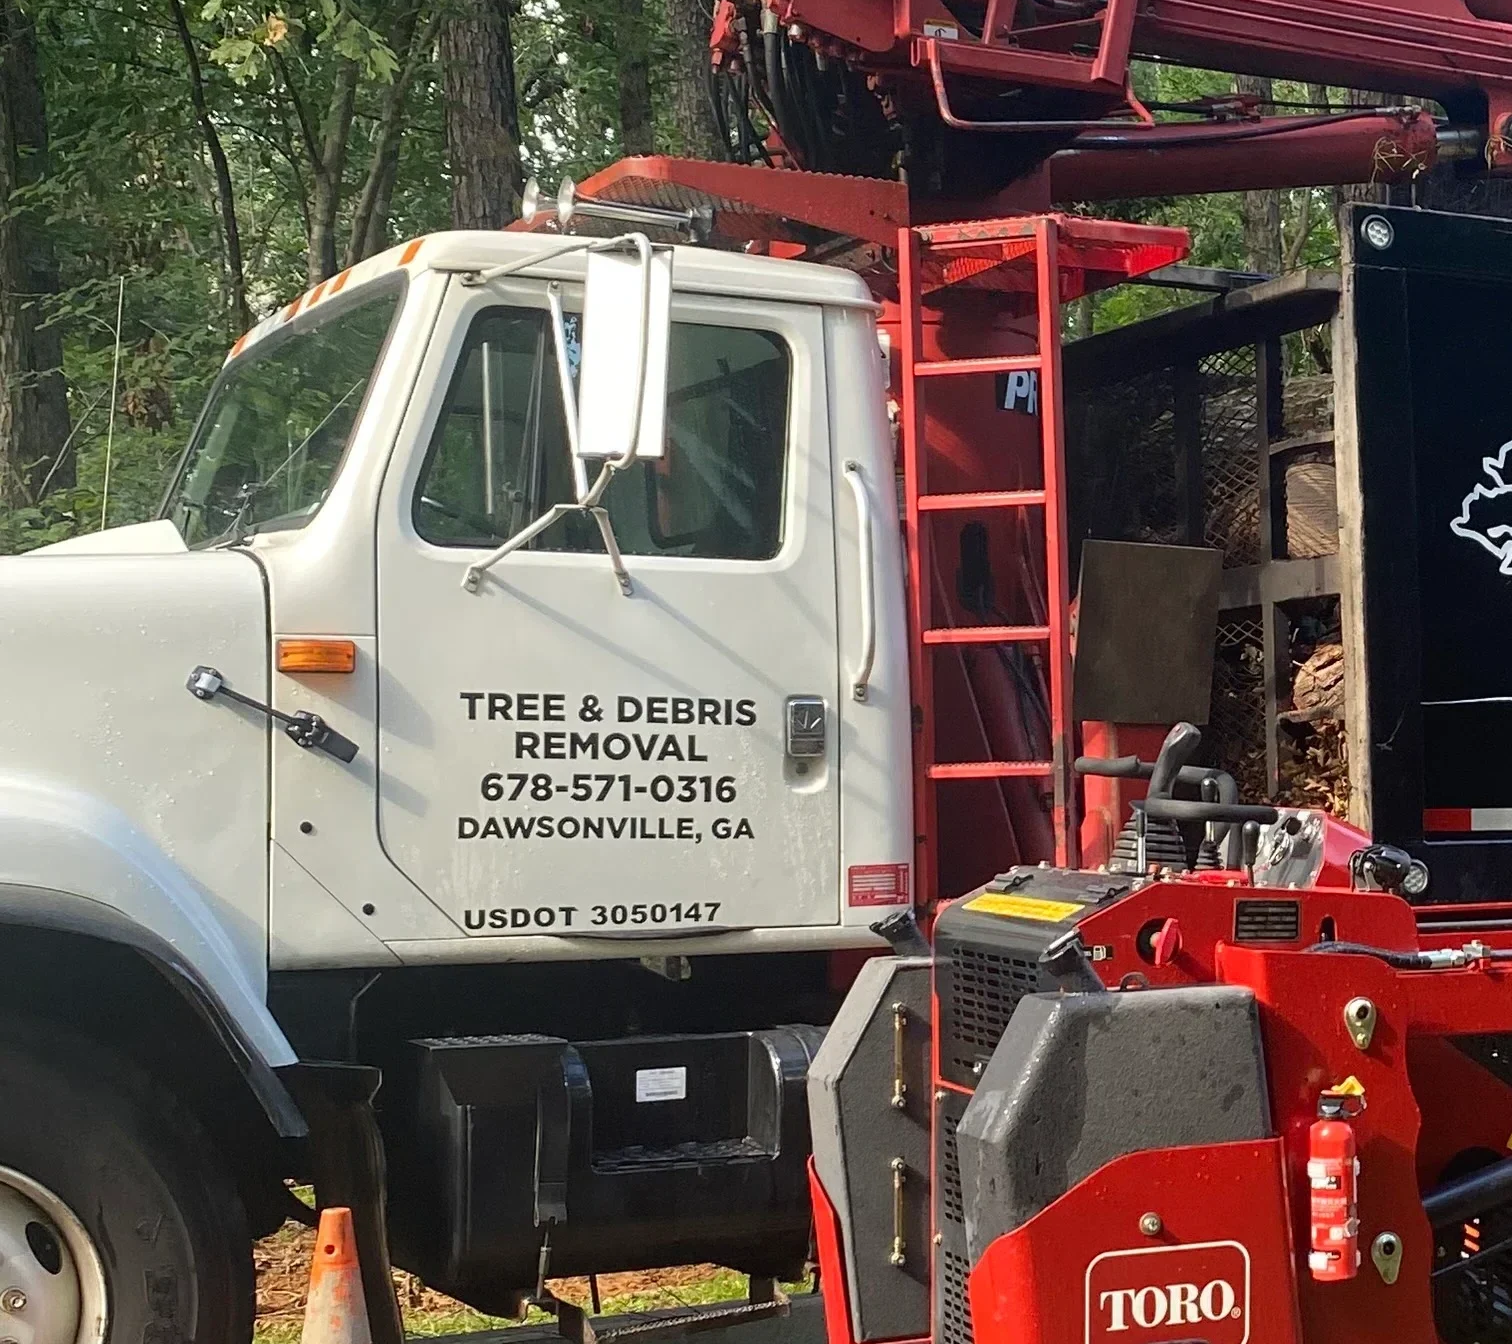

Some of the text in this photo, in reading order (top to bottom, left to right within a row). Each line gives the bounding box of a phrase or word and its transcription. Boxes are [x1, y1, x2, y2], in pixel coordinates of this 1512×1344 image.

[460, 692, 757, 726] TREE & DEBRIS
[514, 731, 708, 762] REMOVAL
[480, 772, 737, 803] 678-571-0316
[457, 816, 755, 844] DAWSONVILLE, GA
[464, 902, 722, 929] USDOT 3050147
